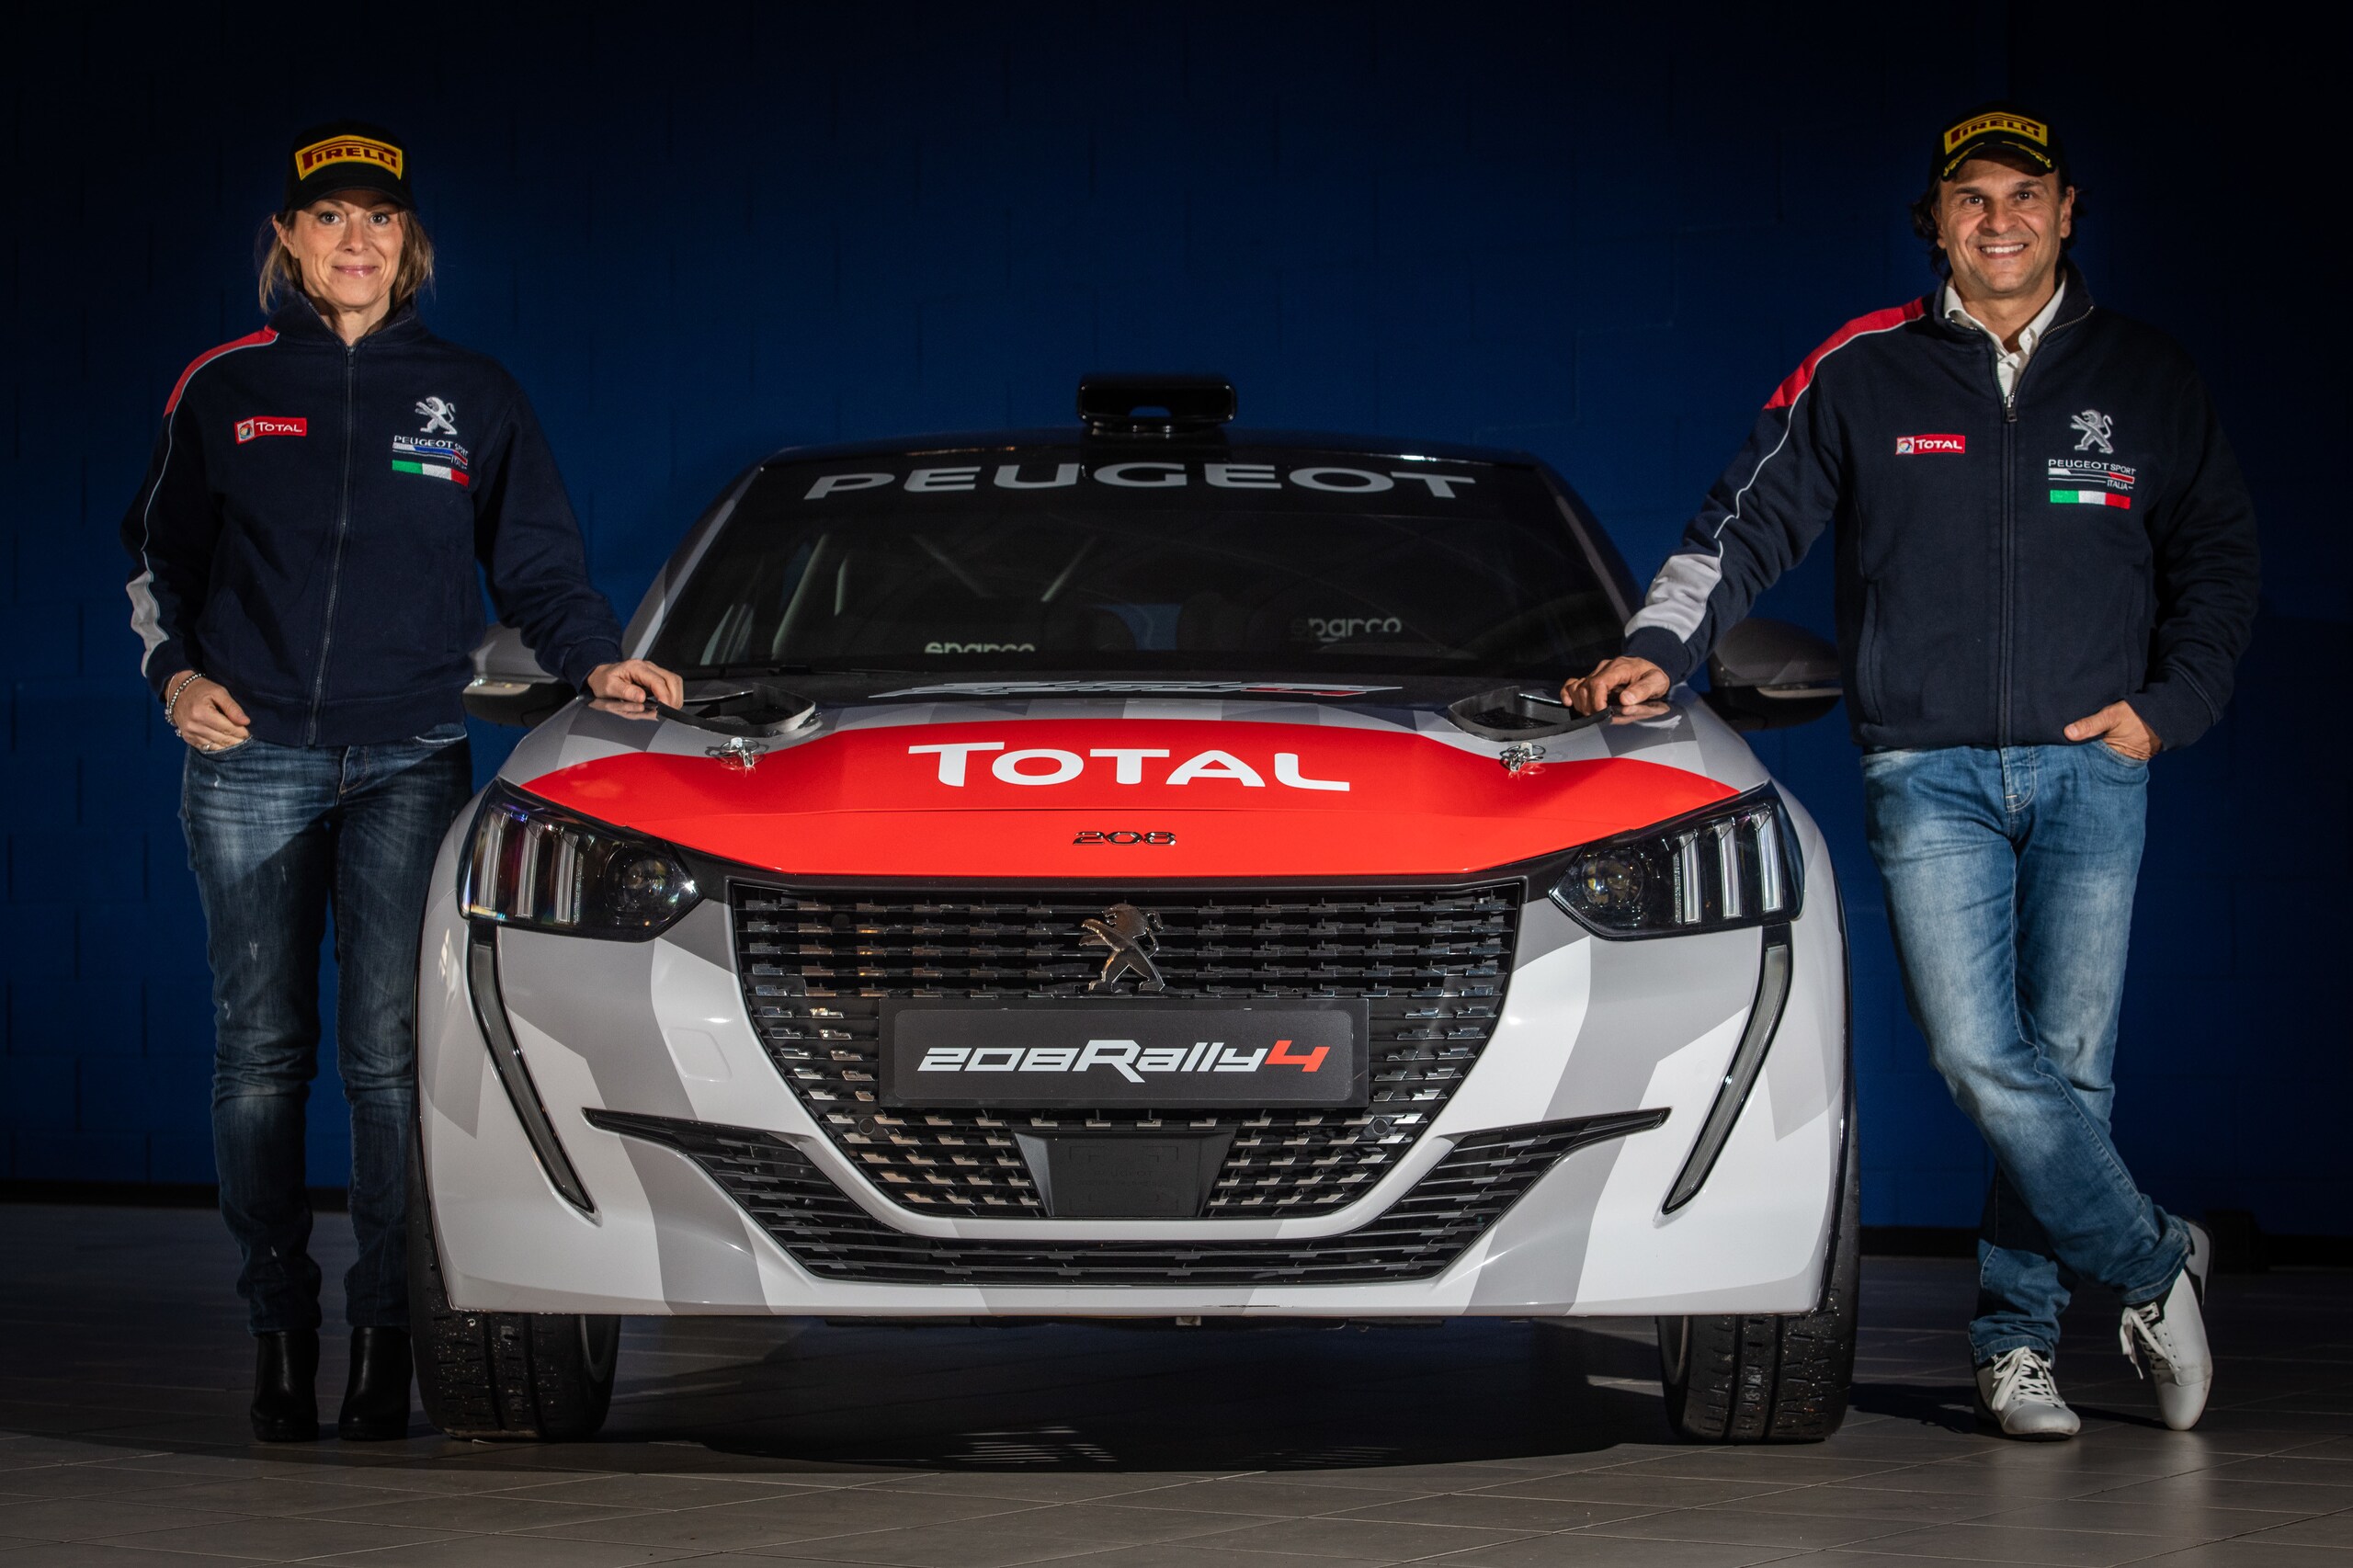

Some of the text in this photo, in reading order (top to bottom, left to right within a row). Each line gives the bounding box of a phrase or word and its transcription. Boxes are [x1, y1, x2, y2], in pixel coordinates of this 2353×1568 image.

[1950, 114, 2040, 144] PIRELLI
[301, 140, 397, 170] PIRELLI
[256, 421, 303, 433] TOTAL
[393, 435, 454, 449] PEUGEOT
[1915, 438, 1963, 450] TOTAL
[2048, 459, 2137, 475] PEUGEOT SPORT
[803, 462, 1476, 499] PEUGEOT
[2107, 479, 2129, 491] ITALIA
[1294, 617, 1402, 642] parco
[908, 742, 1350, 791] TOTAL
[1073, 831, 1177, 846] 208
